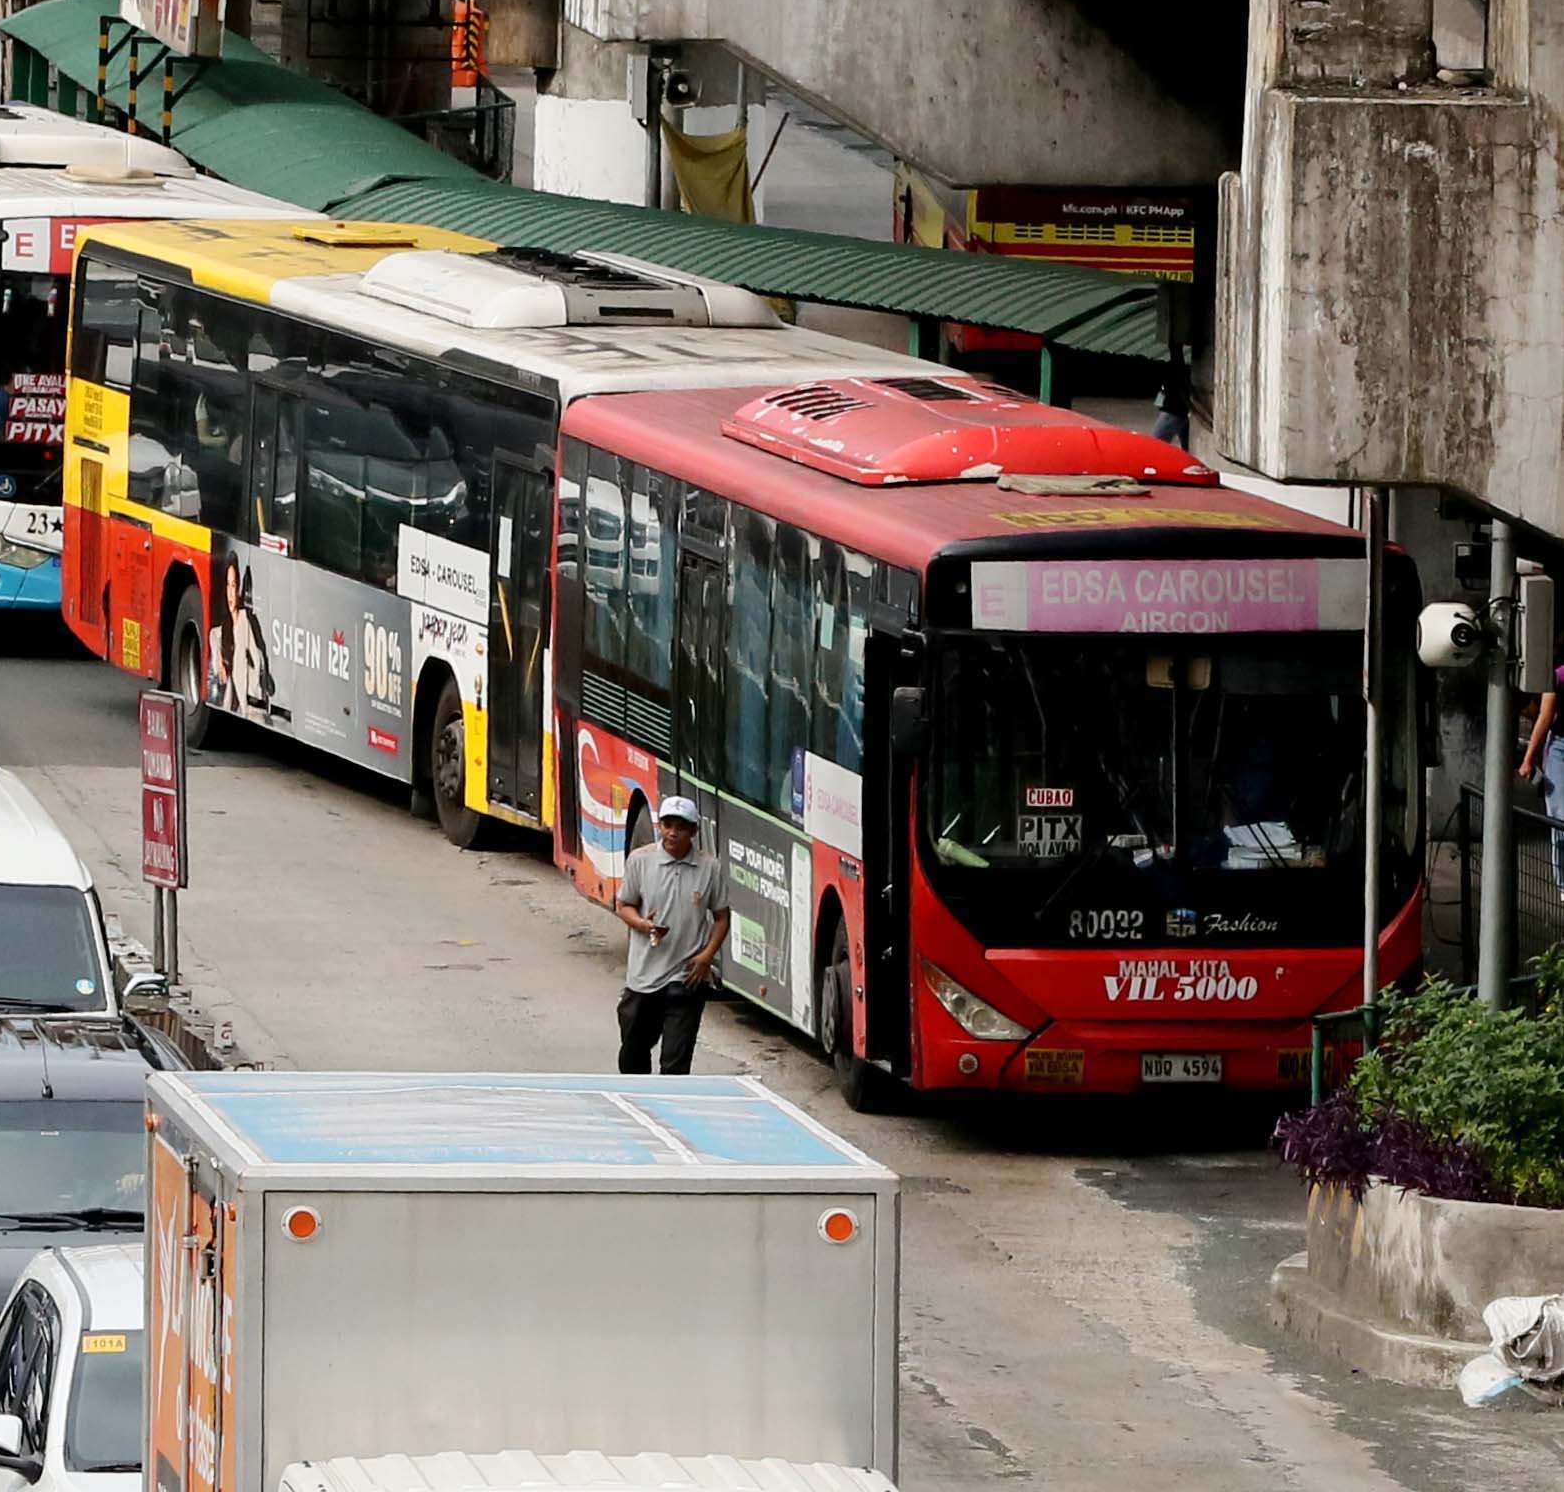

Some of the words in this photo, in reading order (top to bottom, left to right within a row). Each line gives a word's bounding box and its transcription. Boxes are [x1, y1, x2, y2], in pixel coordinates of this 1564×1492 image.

[1126, 205, 1146, 215] KFC
[15, 232, 34, 256] E
[11, 397, 67, 418] PASAY
[7, 421, 65, 442] PITX
[26, 512, 49, 539] 23
[410, 554, 431, 579] EDSA
[436, 564, 478, 596] CAROUSEL
[1041, 569, 1127, 605] EDSA
[1135, 568, 1306, 604] CAROUSEL
[1119, 611, 1230, 632] AIRCON
[272, 619, 321, 670] SHEIN
[1028, 789, 1073, 806] CUBAO
[1019, 816, 1082, 841] PITX
[1203, 913, 1278, 935] Fashion
[1119, 960, 1180, 978] MAHAL
[1190, 960, 1231, 978] KITA
[1103, 975, 1166, 1002] VIL
[1172, 975, 1259, 1002] 5000
[1144, 1058, 1174, 1076] NDQ
[1183, 1057, 1220, 1076] 4594
